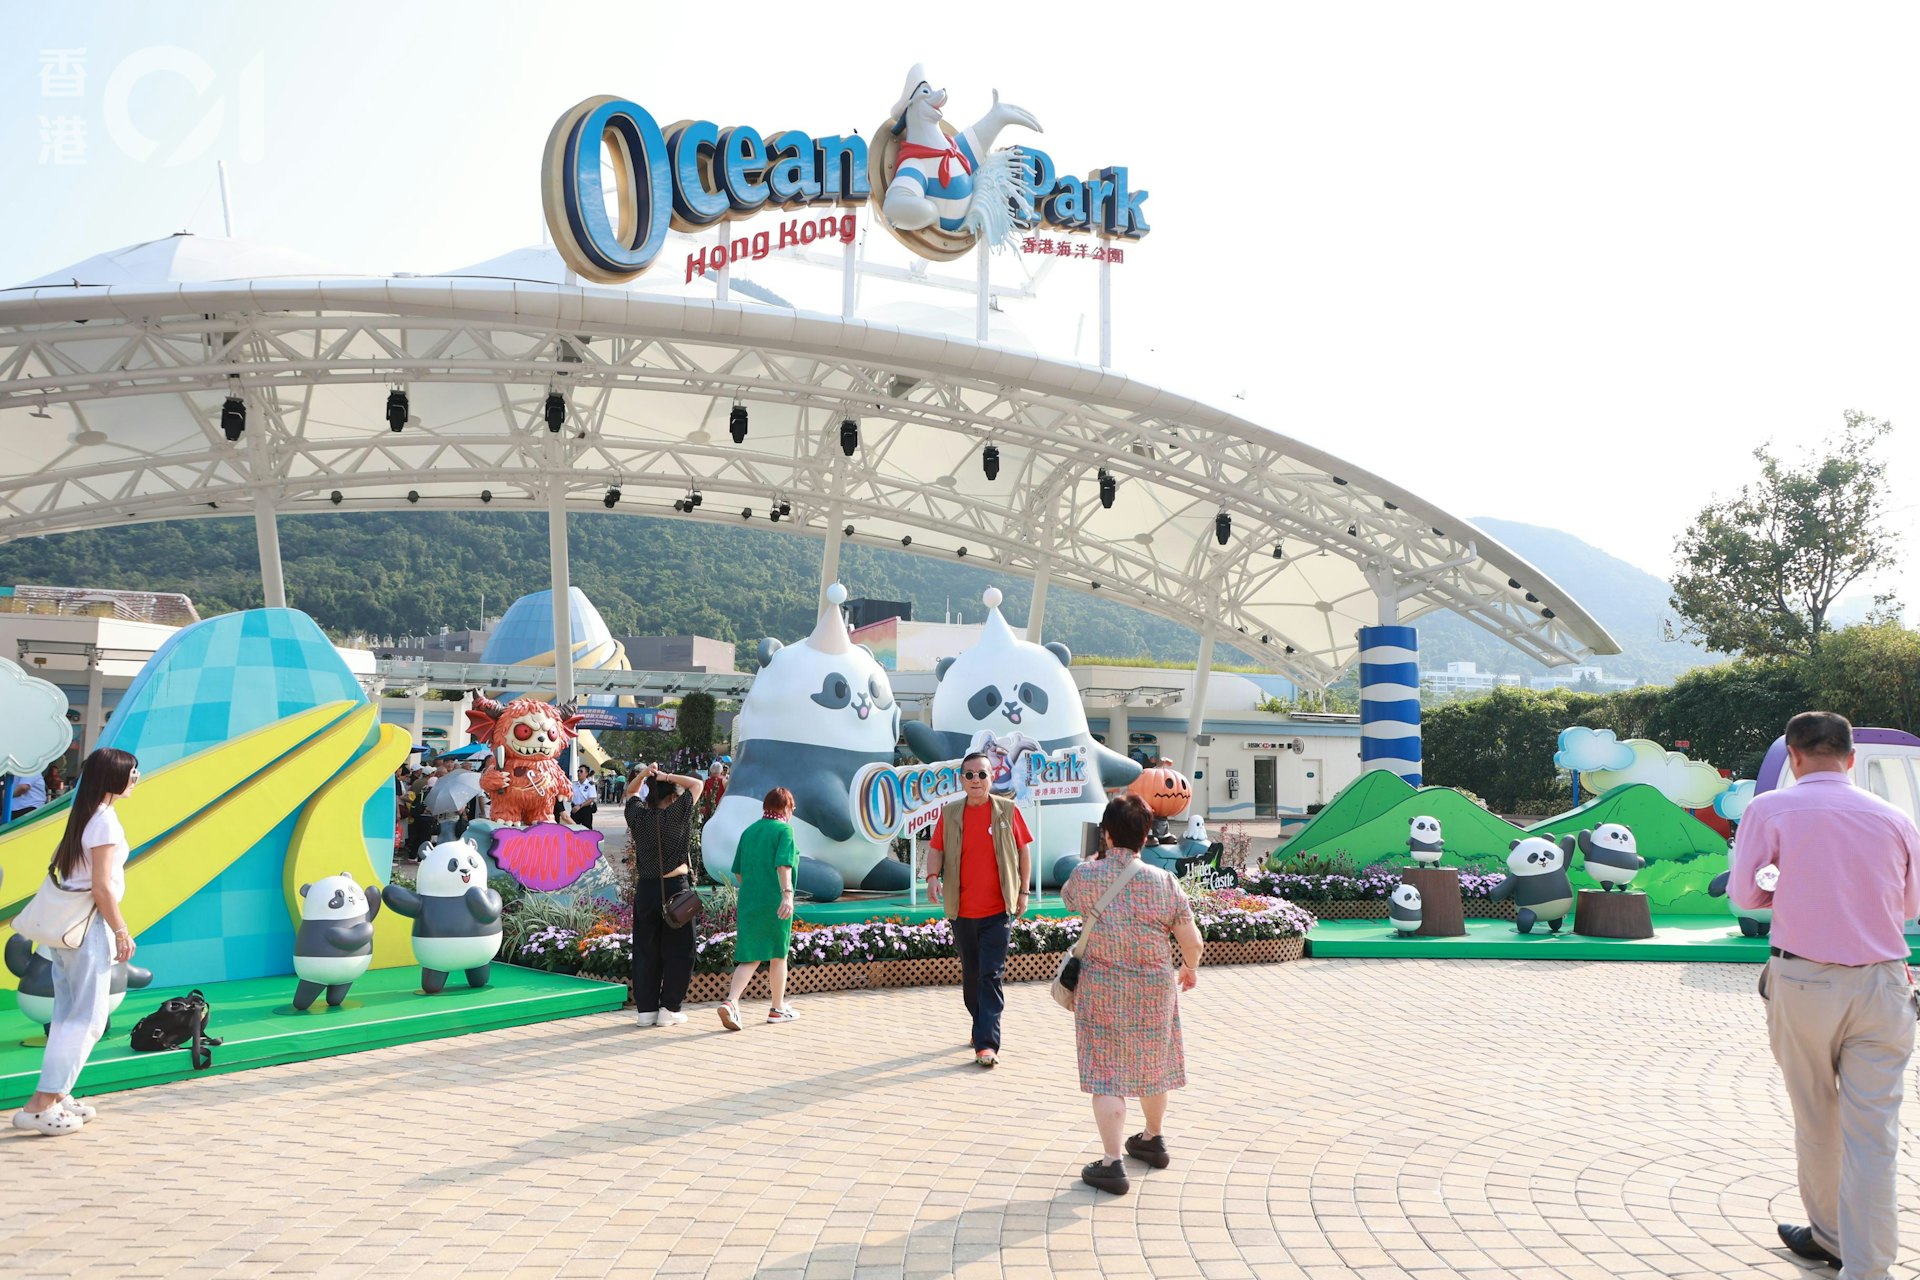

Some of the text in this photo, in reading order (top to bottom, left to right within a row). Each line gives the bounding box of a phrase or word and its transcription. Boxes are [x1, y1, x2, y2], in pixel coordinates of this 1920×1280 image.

[552, 97, 1150, 275] Ocean Park
[685, 214, 857, 285] Hong Kong
[1022, 236, 1124, 264] 香港海洋公園
[1028, 752, 1086, 786] Park
[908, 807, 939, 835] Hong
[1184, 860, 1212, 881] Under
[1210, 871, 1235, 891] Castle
